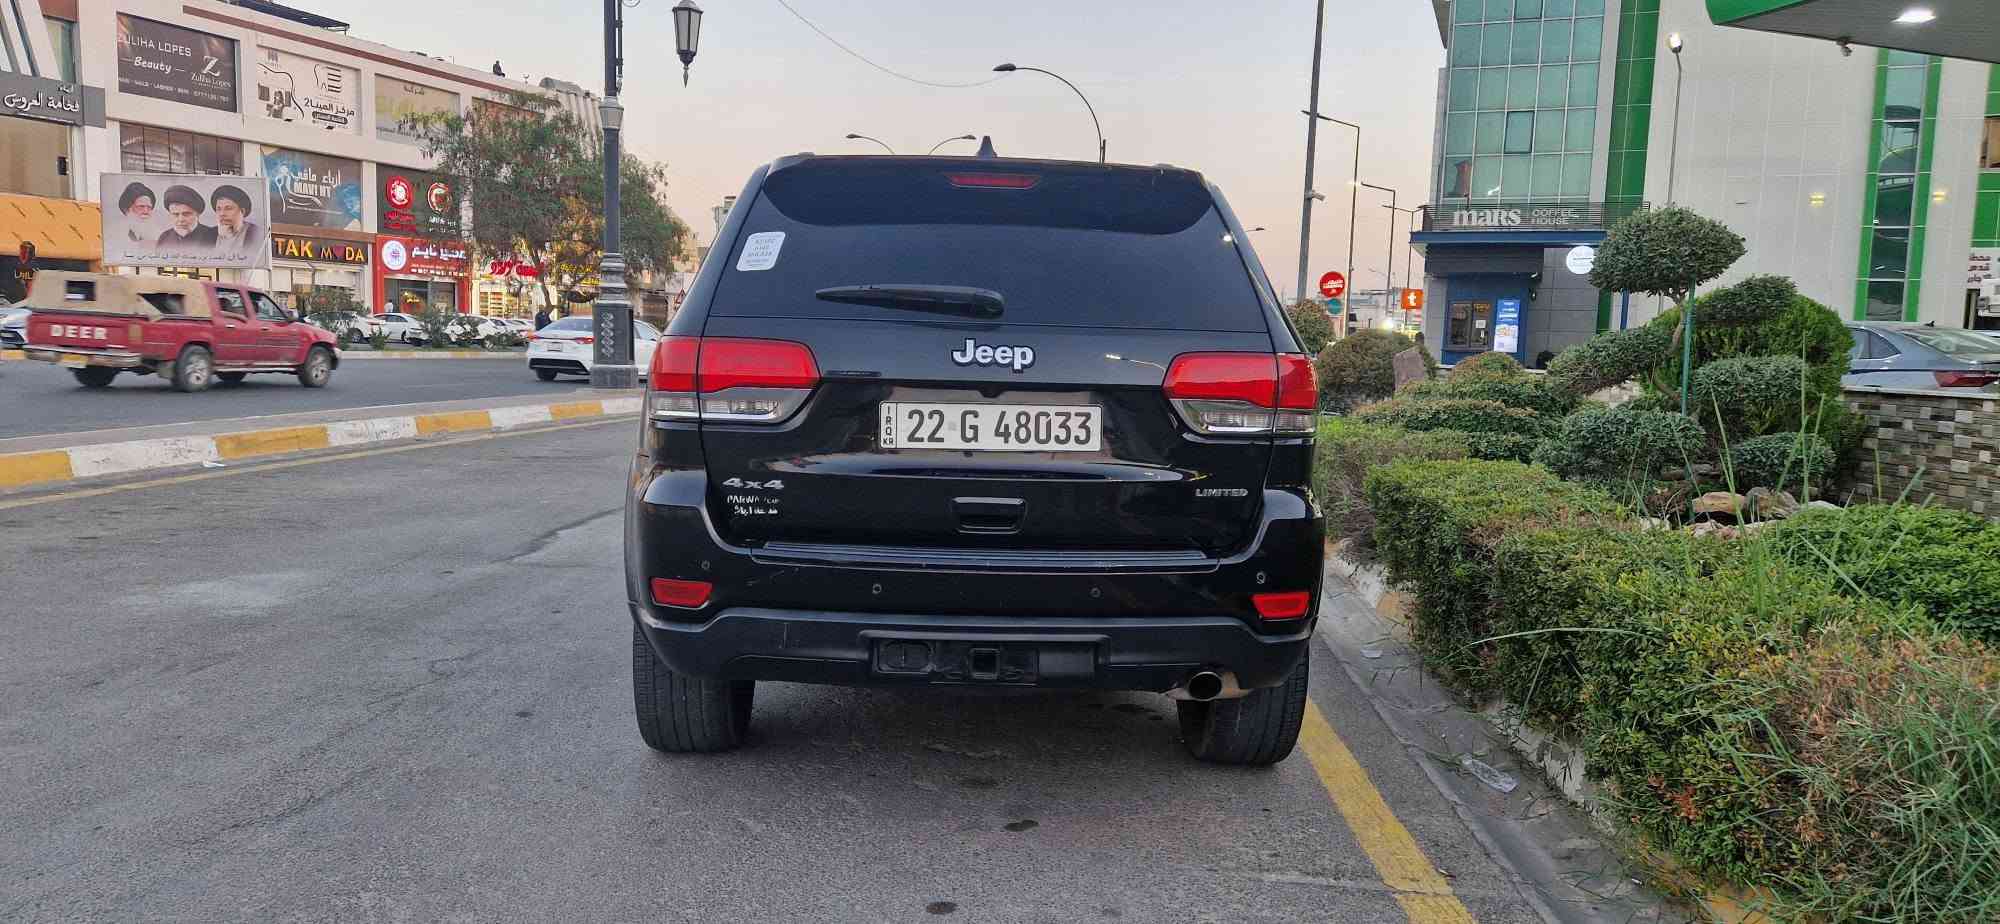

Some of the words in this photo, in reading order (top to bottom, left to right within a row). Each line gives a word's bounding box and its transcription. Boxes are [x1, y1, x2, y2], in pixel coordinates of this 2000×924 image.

[158, 41, 192, 57] LOPES
[134, 56, 172, 74] Beauty
[4, 91, 43, 111] العروس
[274, 238, 313, 259] TAK
[50, 324, 108, 341] DEER
[952, 339, 1035, 371] Jeep
[907, 409, 945, 443] 22
[960, 410, 979, 443] G
[994, 411, 1092, 445] 48033
[1195, 488, 1249, 497] LIMITED
